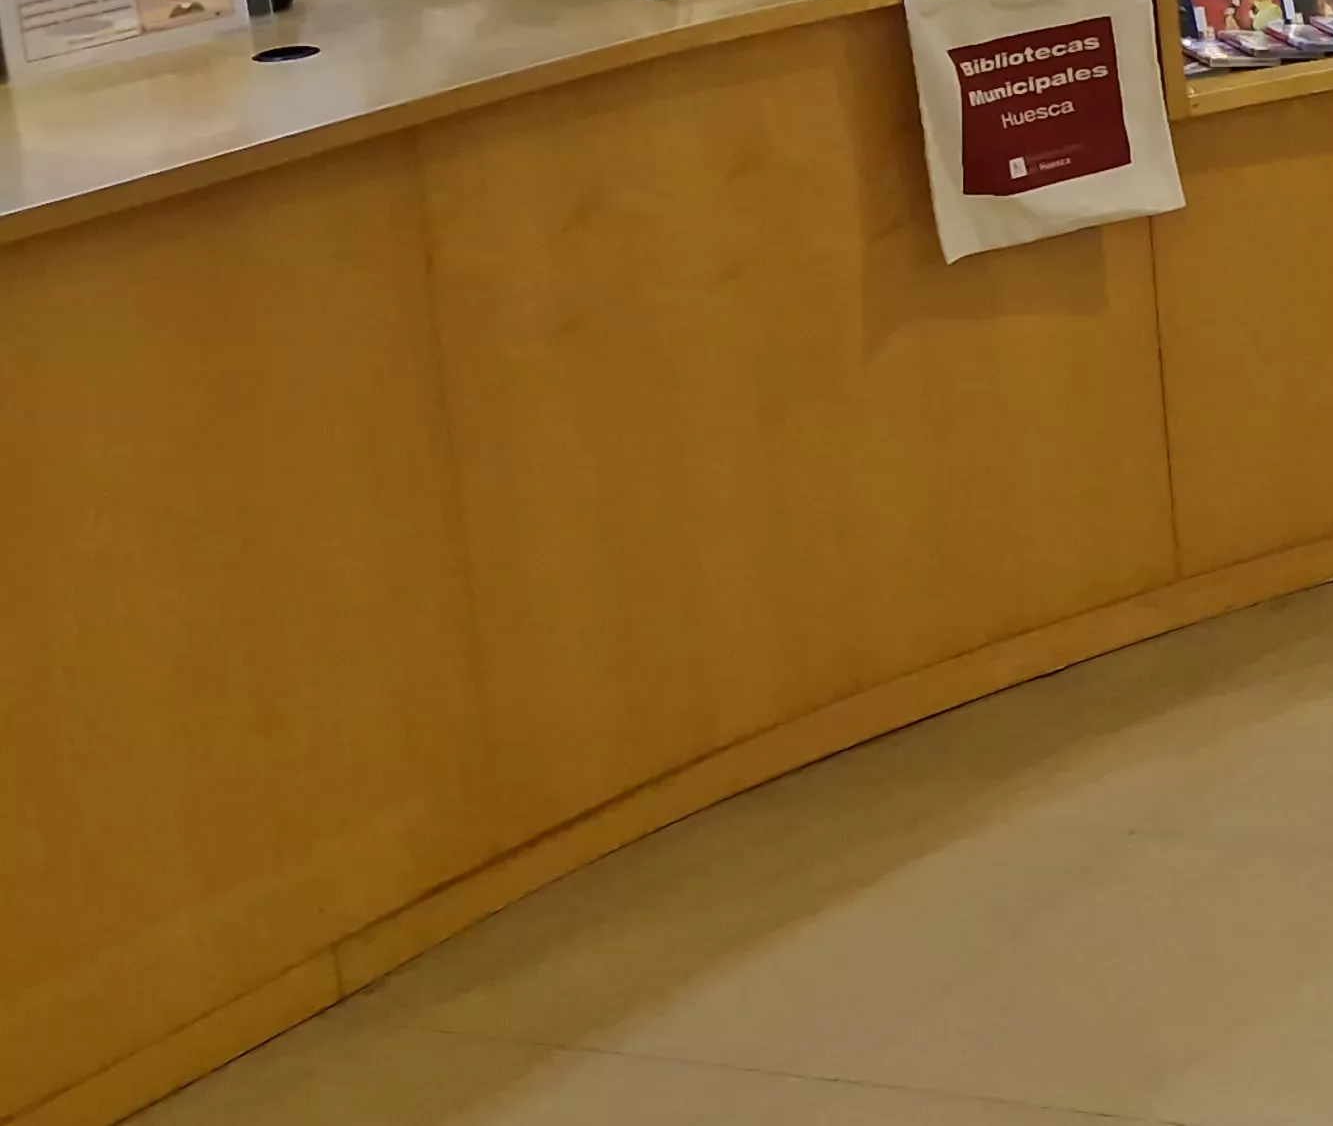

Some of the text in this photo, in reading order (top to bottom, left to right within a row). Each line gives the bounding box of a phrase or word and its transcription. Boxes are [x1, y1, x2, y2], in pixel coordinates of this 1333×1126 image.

[960, 36, 1101, 78] Bibliotecas
[968, 64, 1109, 107] Municipales
[1001, 100, 1076, 129] Huesca
